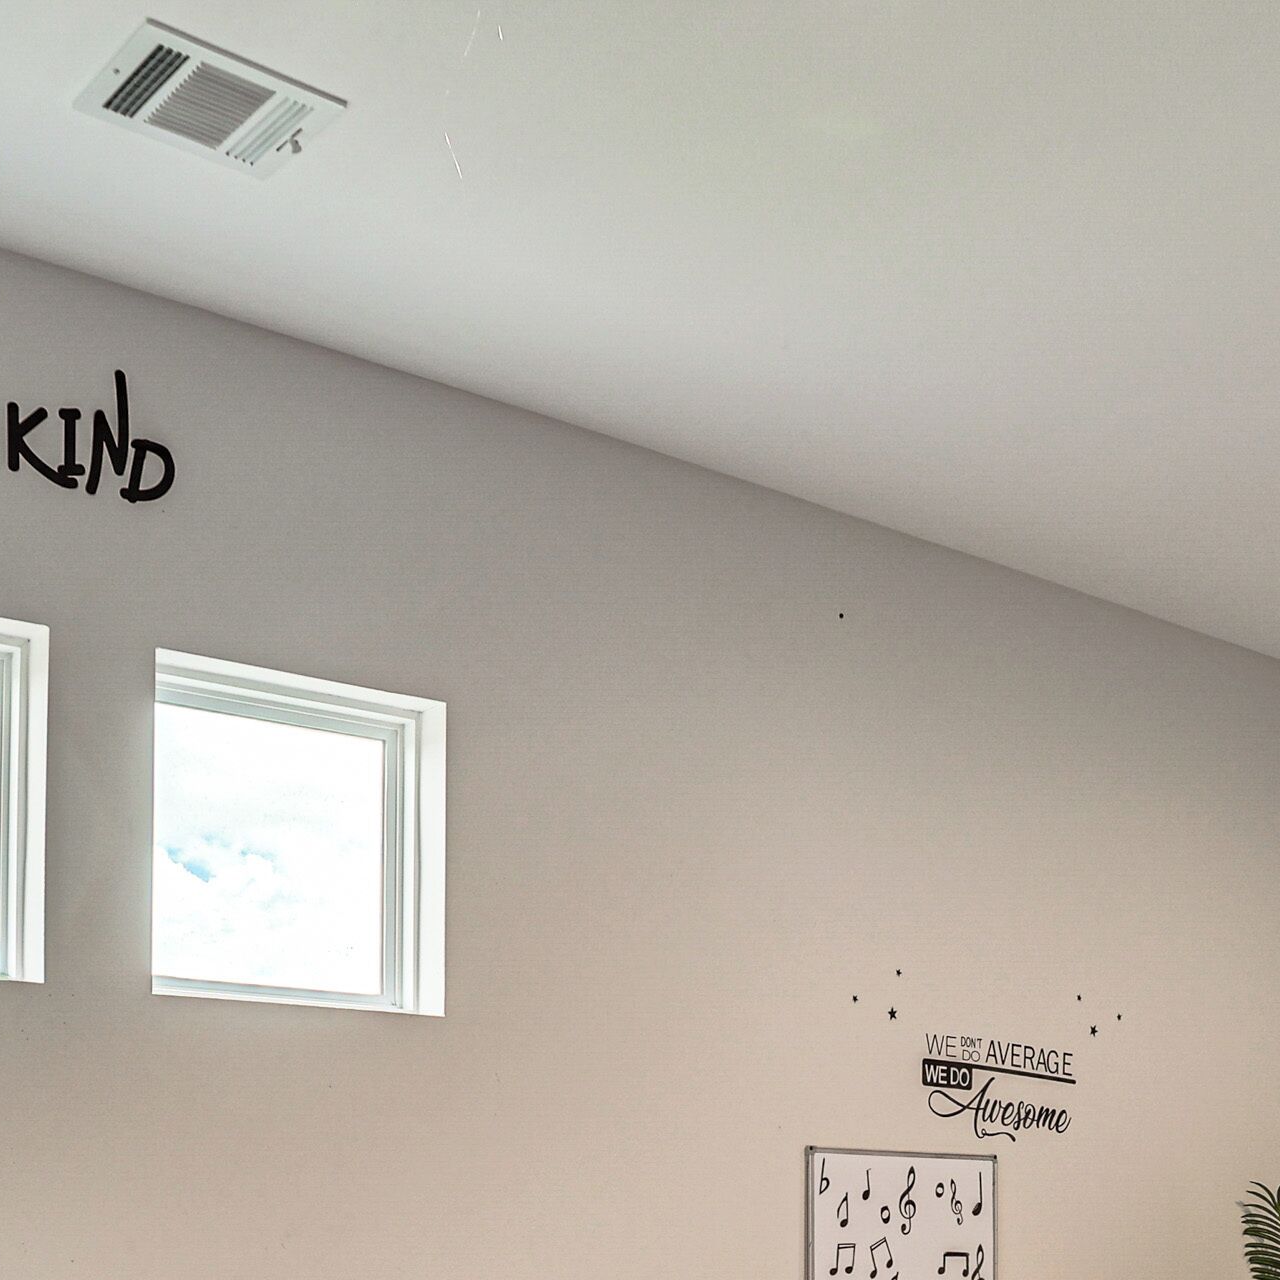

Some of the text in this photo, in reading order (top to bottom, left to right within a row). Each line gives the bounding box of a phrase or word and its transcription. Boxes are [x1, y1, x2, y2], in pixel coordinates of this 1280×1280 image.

[6, 369, 176, 505] KIND
[924, 1063, 970, 1087] WE DO
[925, 1032, 957, 1058] WE
[962, 1049, 981, 1062] DO
[984, 1039, 1074, 1077] AVERAGE
[927, 1076, 1072, 1143] Awesome
